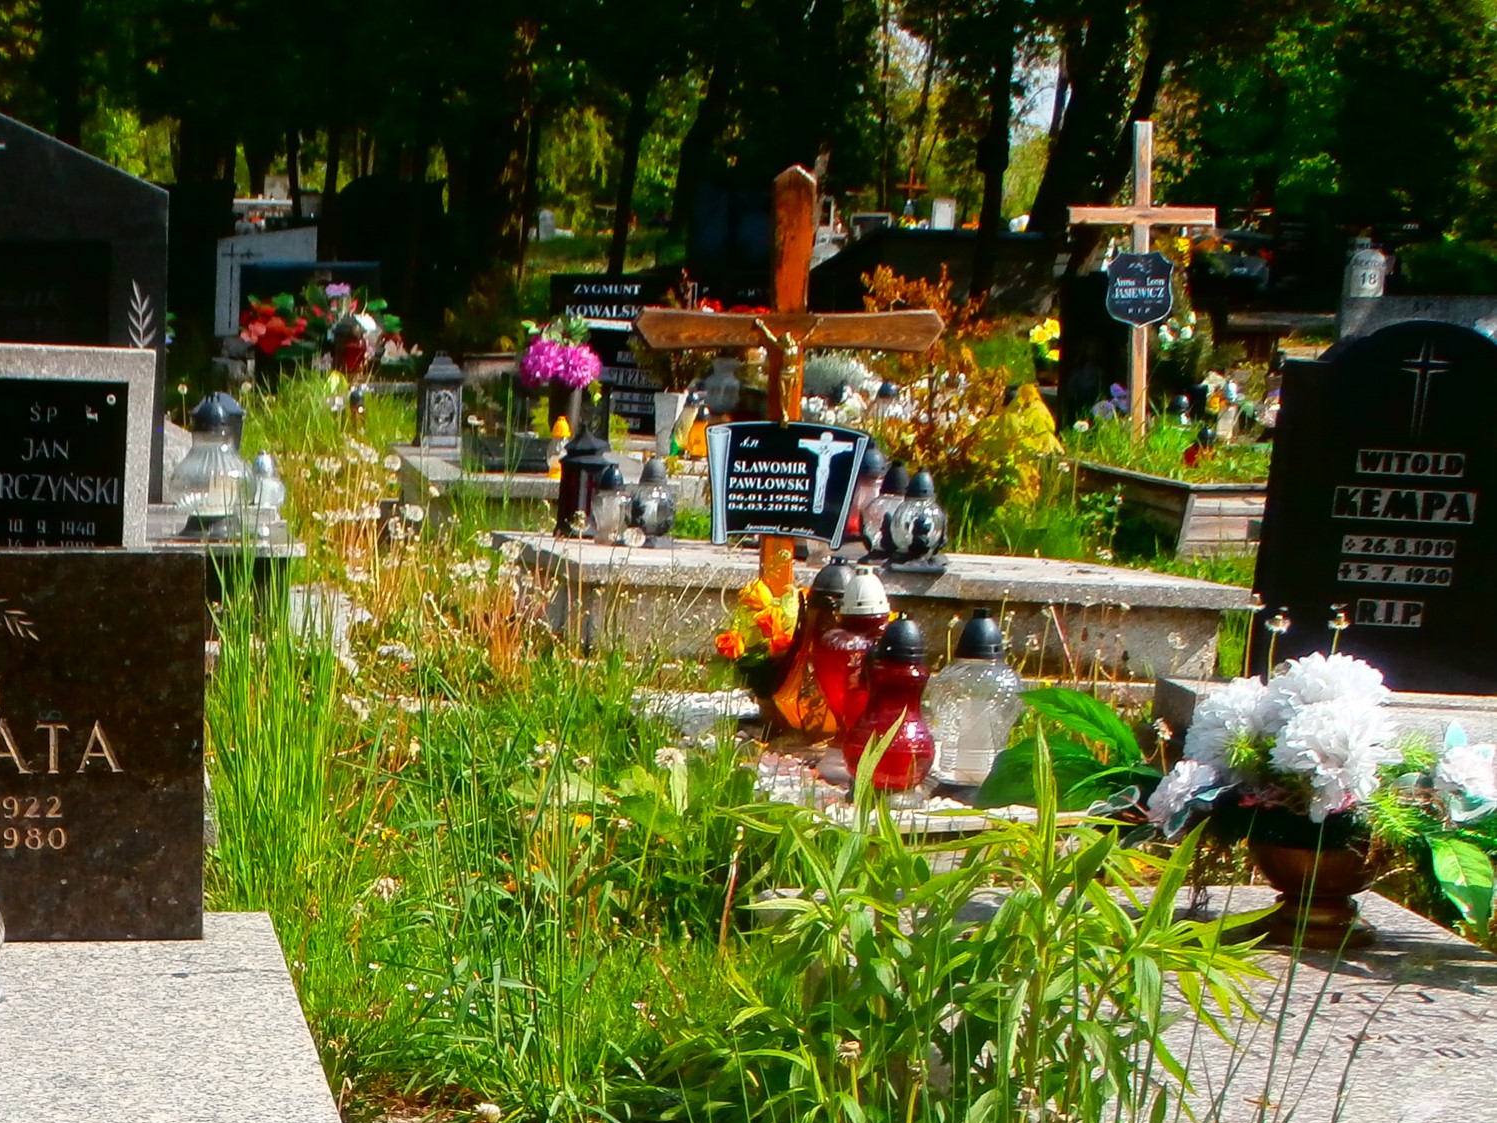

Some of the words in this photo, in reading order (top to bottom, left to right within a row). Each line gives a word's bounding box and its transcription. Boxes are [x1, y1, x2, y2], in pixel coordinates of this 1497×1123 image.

[1360, 272, 1377, 286] 18
[573, 284, 641, 295] ZYGMUNT
[565, 304, 642, 318] KOWALSK
[21, 438, 69, 461] JAN
[1358, 450, 1464, 476] WITOLD
[1332, 487, 1472, 522] KEMPA
[61, 520, 96, 536] 1940
